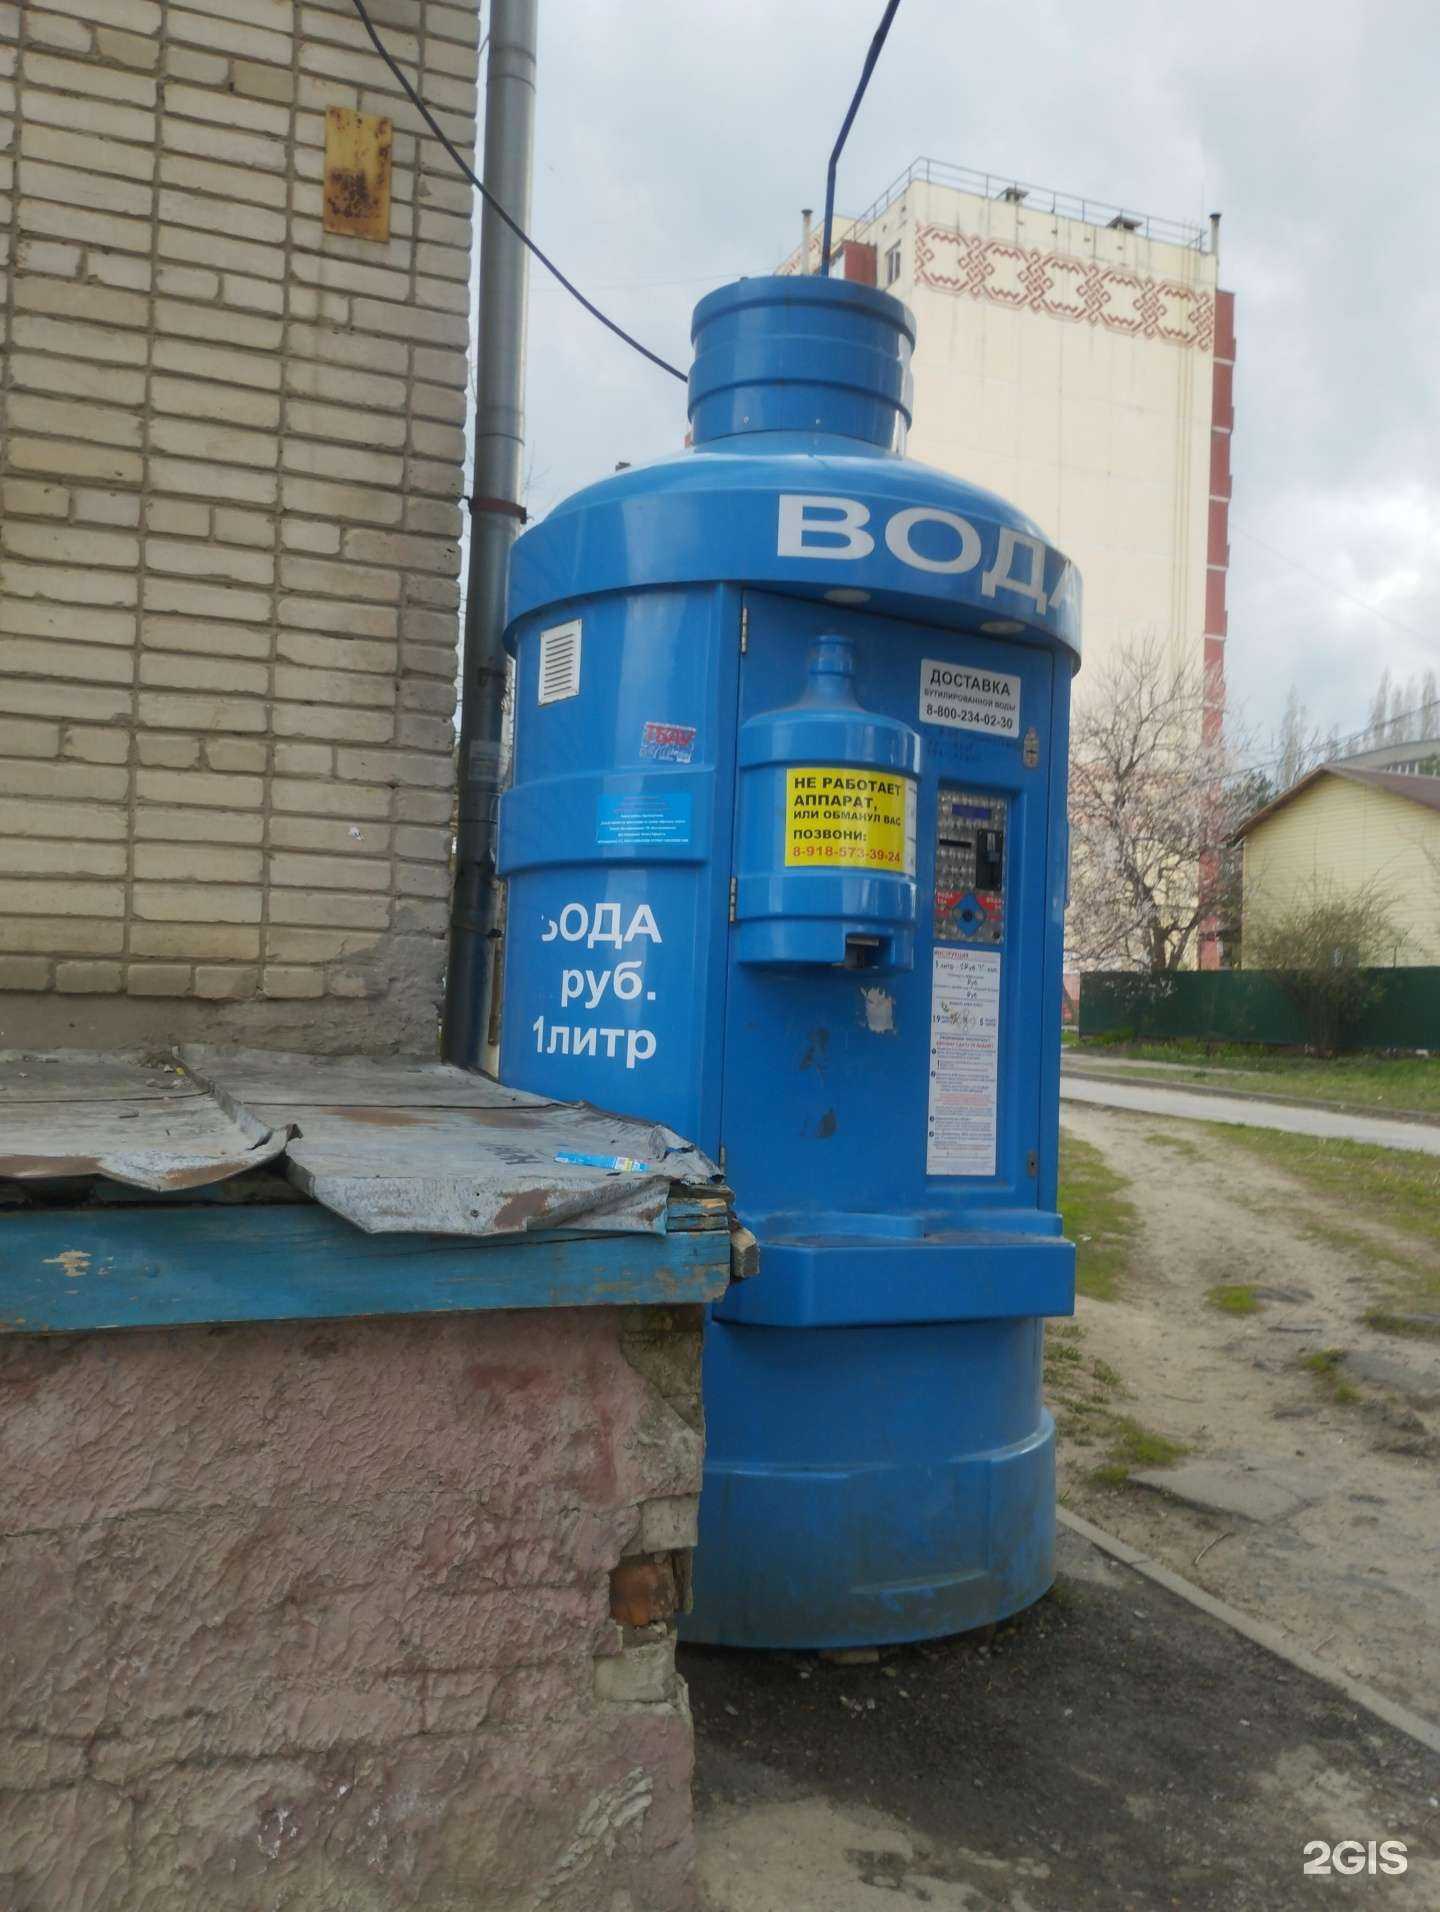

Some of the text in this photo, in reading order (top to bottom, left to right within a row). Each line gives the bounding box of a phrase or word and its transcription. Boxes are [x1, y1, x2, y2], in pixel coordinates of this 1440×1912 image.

[930, 668, 1010, 696] ДОСТАВКА
[926, 704, 1013, 729] 8-800-234-02-30
[794, 777, 900, 796] НЕ РАБОТАЕТ
[794, 794, 877, 811] АППАРАТ,
[793, 810, 901, 826] ИЛИ ОБМАНУЛ ВАС
[793, 829, 866, 841] ПОЗВОНИ:
[792, 846, 900, 863] 8-918-573-39-24
[561, 961, 656, 1009] руб.
